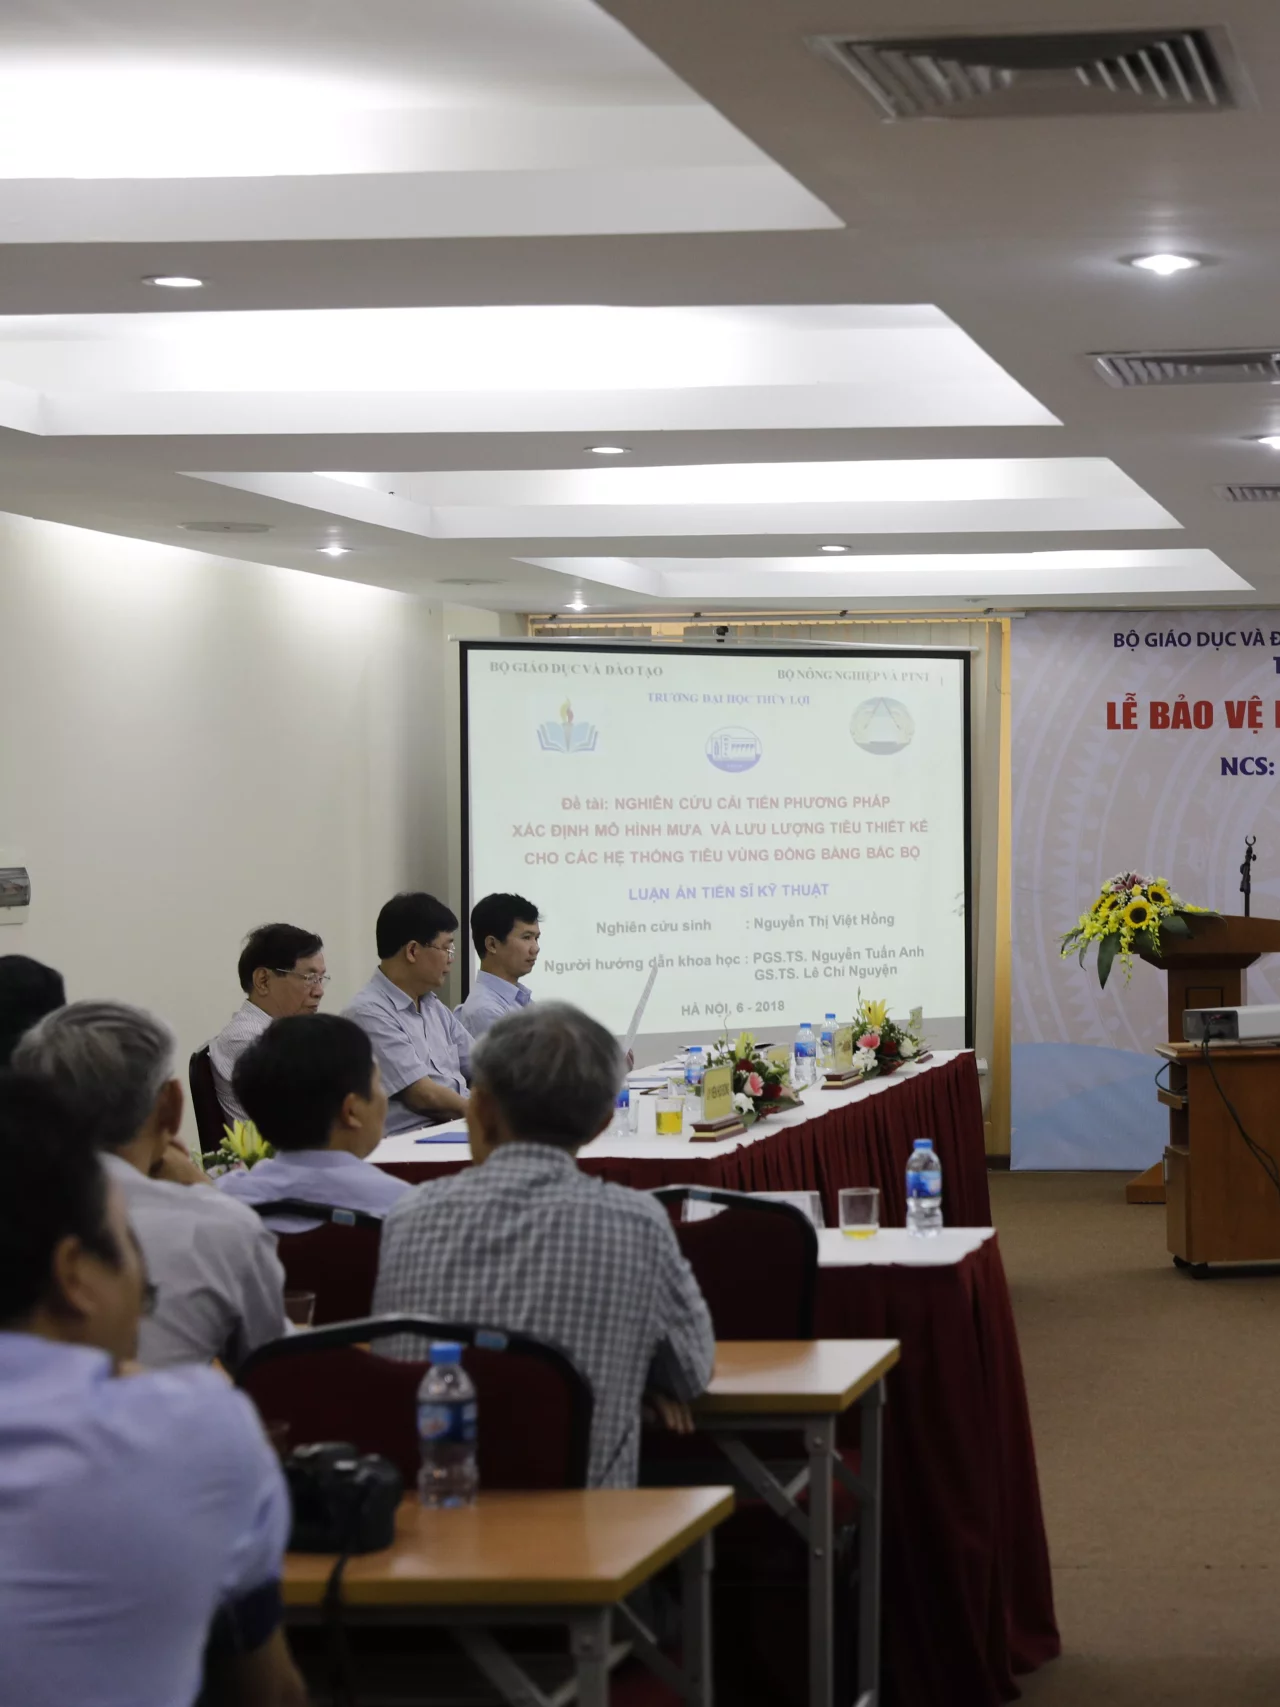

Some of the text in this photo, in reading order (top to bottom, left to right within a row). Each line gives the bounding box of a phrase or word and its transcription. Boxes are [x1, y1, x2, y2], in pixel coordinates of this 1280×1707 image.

[1114, 630, 1140, 651] BỘ
[1145, 629, 1191, 647] GIÁO
[1197, 632, 1236, 650] DỤC
[1240, 628, 1265, 646] VÀ
[1106, 692, 1138, 730] LỄ
[1150, 694, 1214, 730] BẢO
[1224, 695, 1263, 734] VỆ
[1220, 756, 1275, 776] NCS:
[596, 911, 895, 936] Nghiên cứu sinh Nguyễn Thị Việt Hồng
[544, 957, 591, 975] Người
[595, 957, 644, 972] hướng
[678, 955, 712, 967] khoa
[716, 954, 741, 969] học
[753, 951, 808, 964] PGS.TS.
[811, 947, 861, 964] Nguyễn
[865, 945, 896, 959] Tuấn
[899, 946, 925, 958] Anh
[754, 968, 799, 980] GS.TS.
[803, 966, 819, 979] Lê
[681, 1002, 700, 1016] HÀ
[736, 1002, 744, 1013] 6
[755, 1001, 785, 1012] 2018
